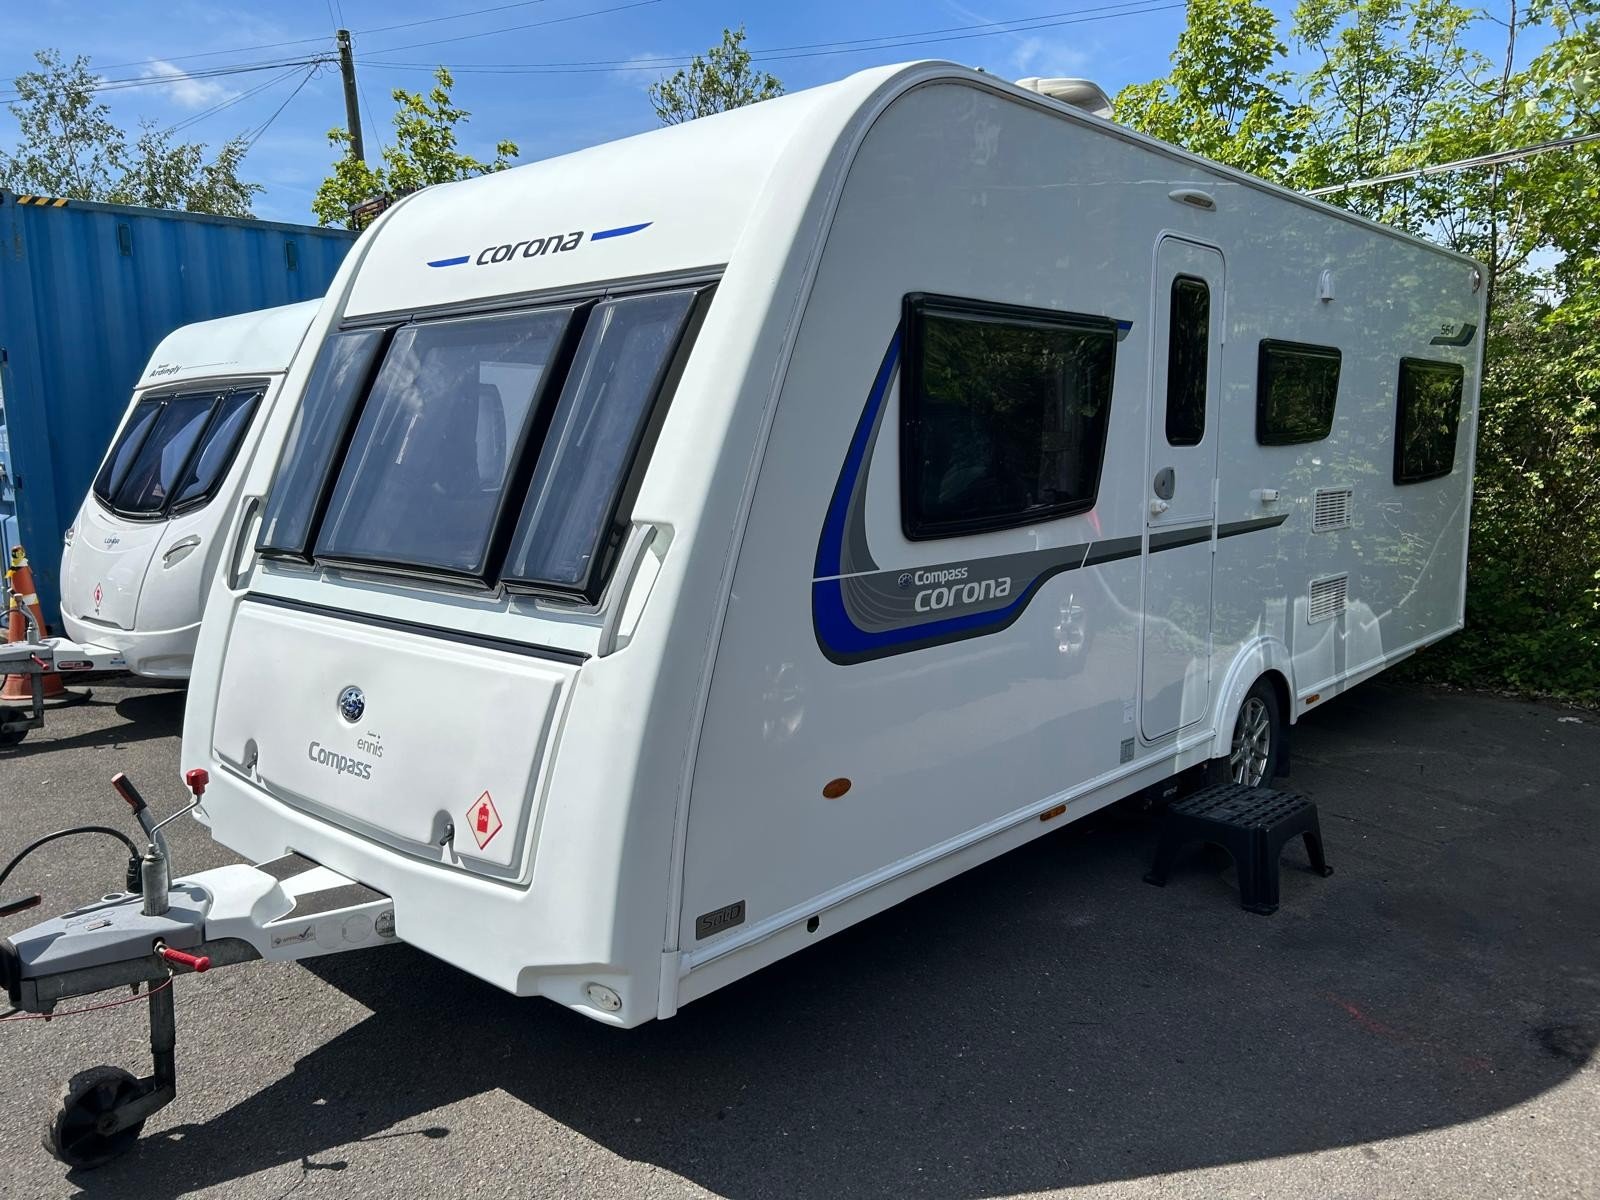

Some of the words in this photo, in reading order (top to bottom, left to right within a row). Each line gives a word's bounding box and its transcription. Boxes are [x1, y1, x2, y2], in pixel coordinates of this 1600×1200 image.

[476, 231, 585, 266] corona
[914, 567, 968, 585] Compass
[914, 577, 1011, 612] corona
[308, 741, 372, 780] Compass
[357, 738, 384, 758] ennis
